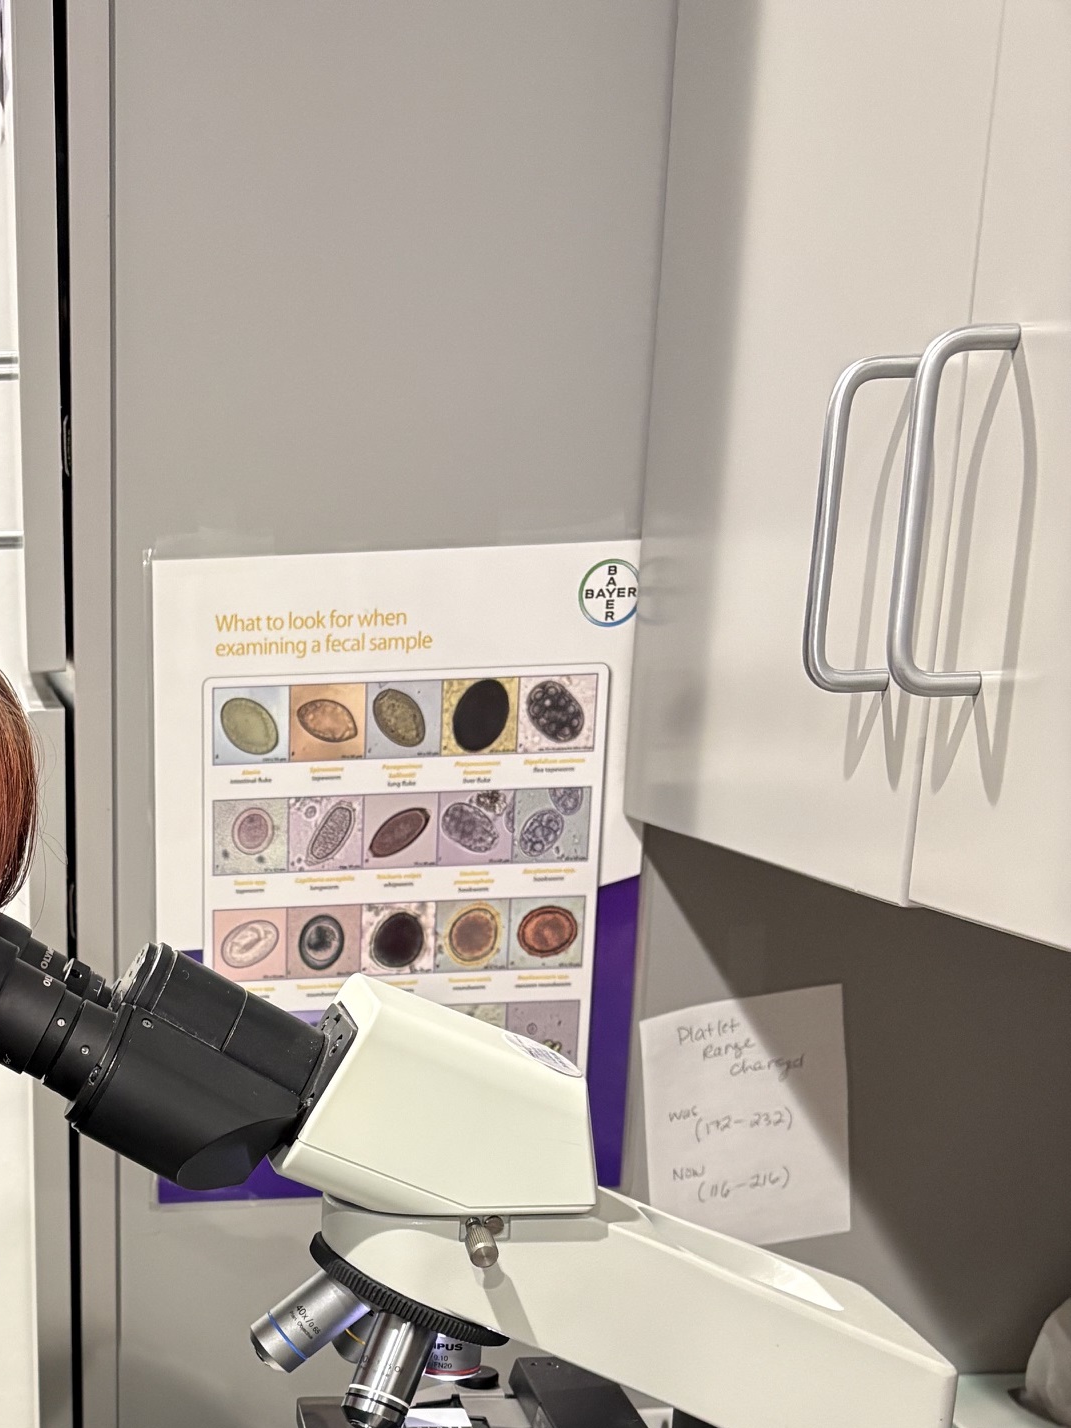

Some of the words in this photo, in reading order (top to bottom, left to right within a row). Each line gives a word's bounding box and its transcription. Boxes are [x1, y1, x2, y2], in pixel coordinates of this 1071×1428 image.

[585, 587, 637, 599] BAYER
[604, 565, 618, 621] BAYER
[215, 614, 262, 632] What
[266, 615, 284, 630] to
[288, 610, 326, 630] look
[330, 609, 354, 628] for
[358, 608, 407, 627] when
[215, 636, 307, 659] examining
[311, 639, 321, 653] a
[325, 632, 365, 652] fecal
[370, 631, 433, 654] sample
